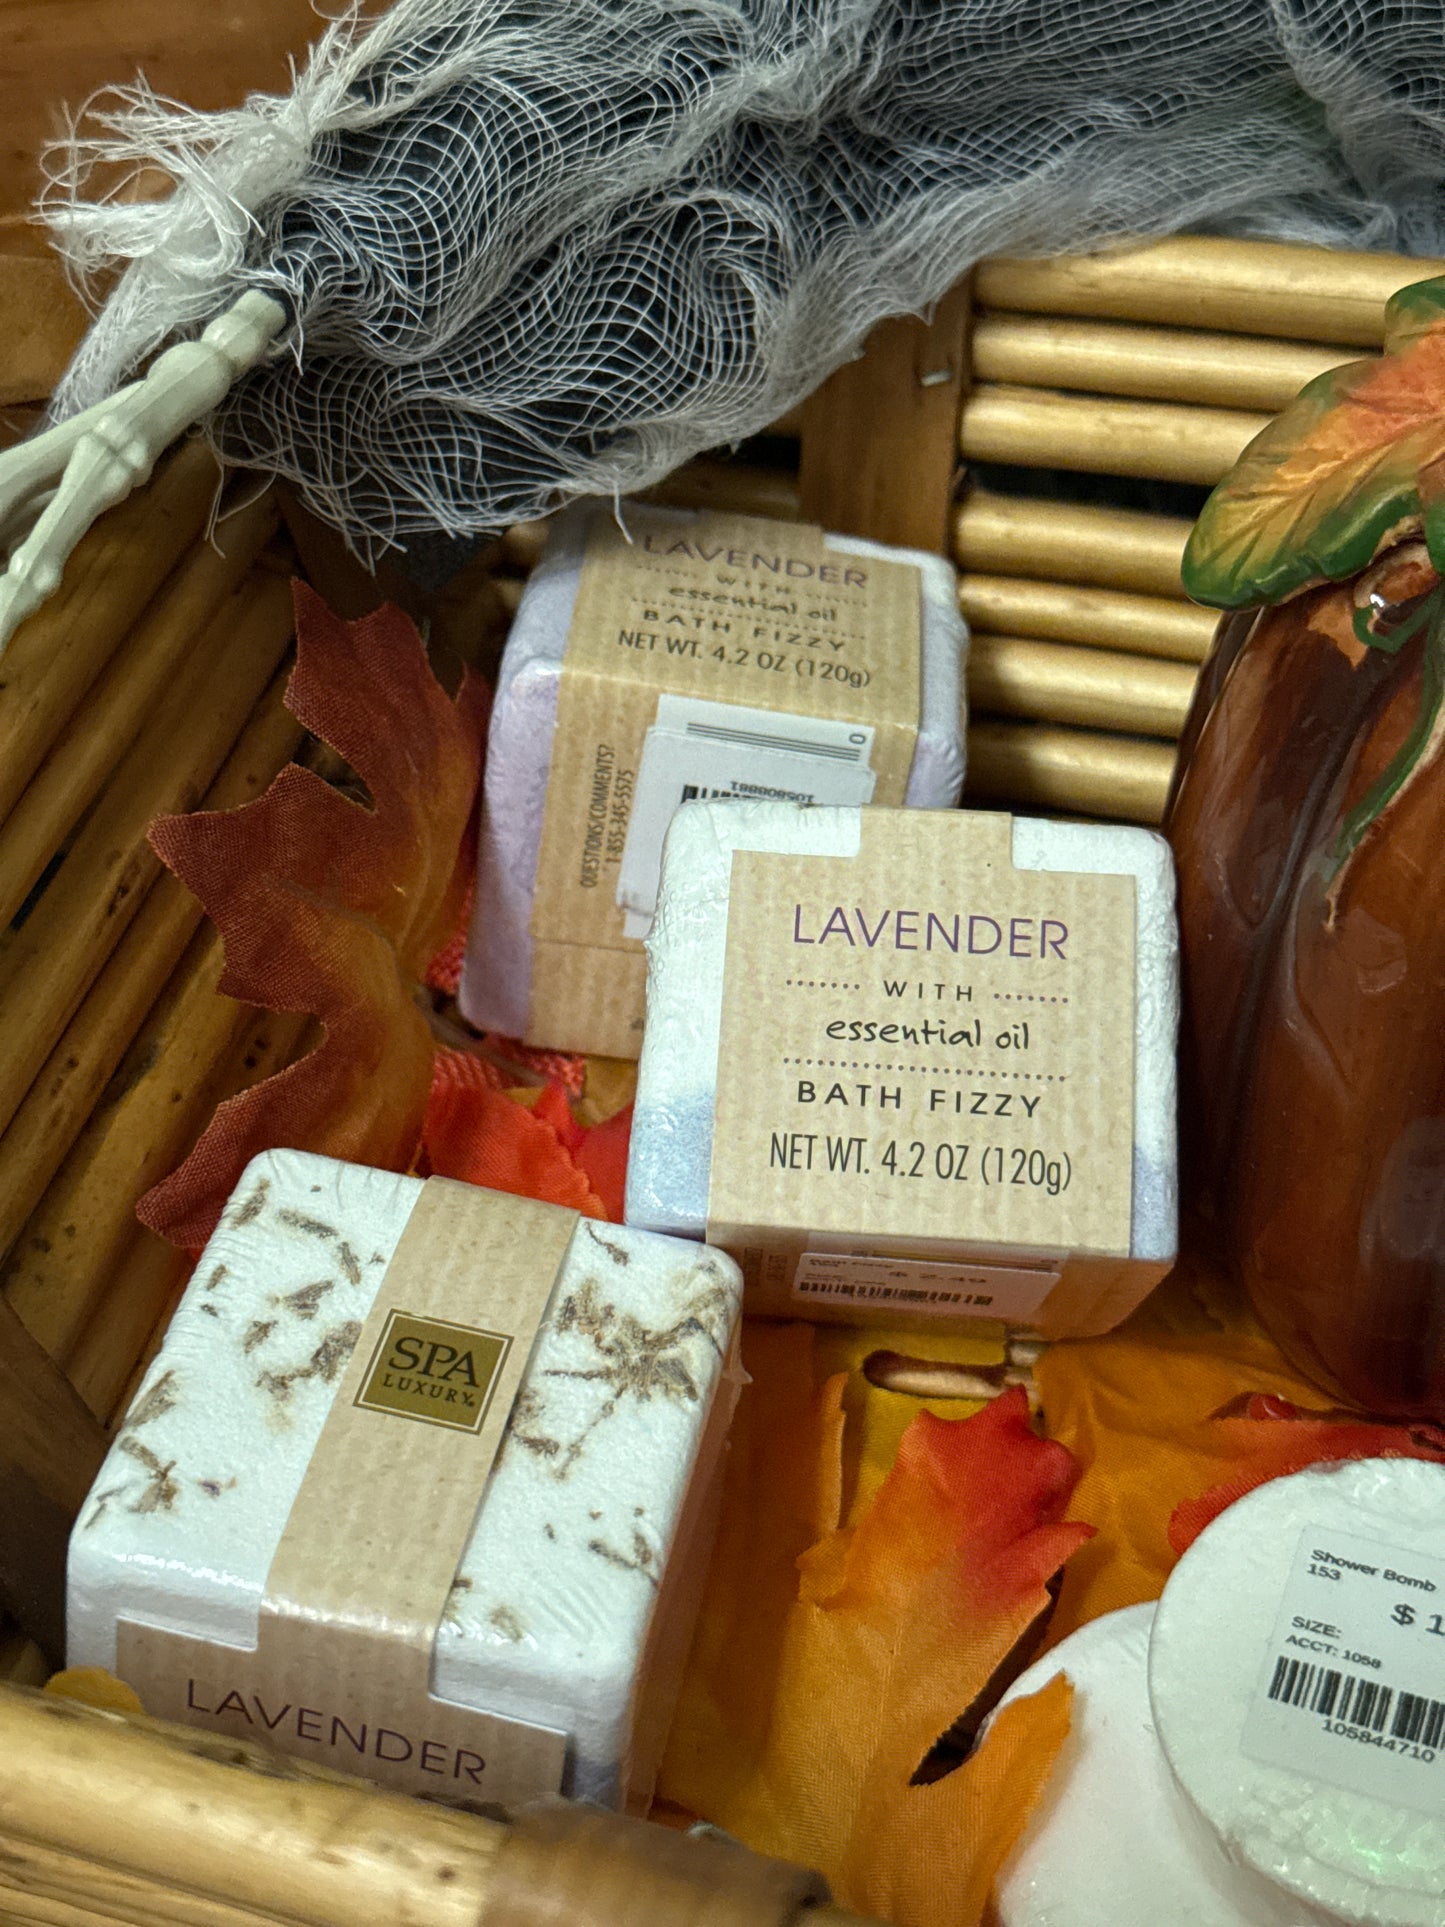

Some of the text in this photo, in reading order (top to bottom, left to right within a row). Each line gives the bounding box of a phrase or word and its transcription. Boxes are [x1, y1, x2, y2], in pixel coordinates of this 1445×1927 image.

[643, 534, 869, 589] LAVENDER
[668, 586, 837, 621] essential oil
[716, 573, 791, 595] WITH
[643, 609, 846, 652] BATH FIZZY
[618, 629, 871, 689] NET WT. 4.2 OZ (120g)
[580, 743, 616, 889] QUESTIONS/COMMENTS?
[792, 903, 1070, 960] LAVENDER
[883, 980, 973, 1003] WITH
[825, 1018, 1031, 1051] essential oil
[796, 1079, 1042, 1119] BATH FIZZY
[769, 1131, 1073, 1196] NET WT. 4.2 OZ (120g)
[388, 1336, 480, 1388] SPA
[1306, 1562, 1342, 1582] 153
[1310, 1548, 1437, 1593] Shower Bomb
[1290, 1615, 1343, 1640] SIZE:
[1390, 1603, 1417, 1627] $
[1285, 1633, 1383, 1670] ACCT: 1058
[186, 1677, 488, 1787] LAVENDER
[1320, 1718, 1436, 1764] 105844710
